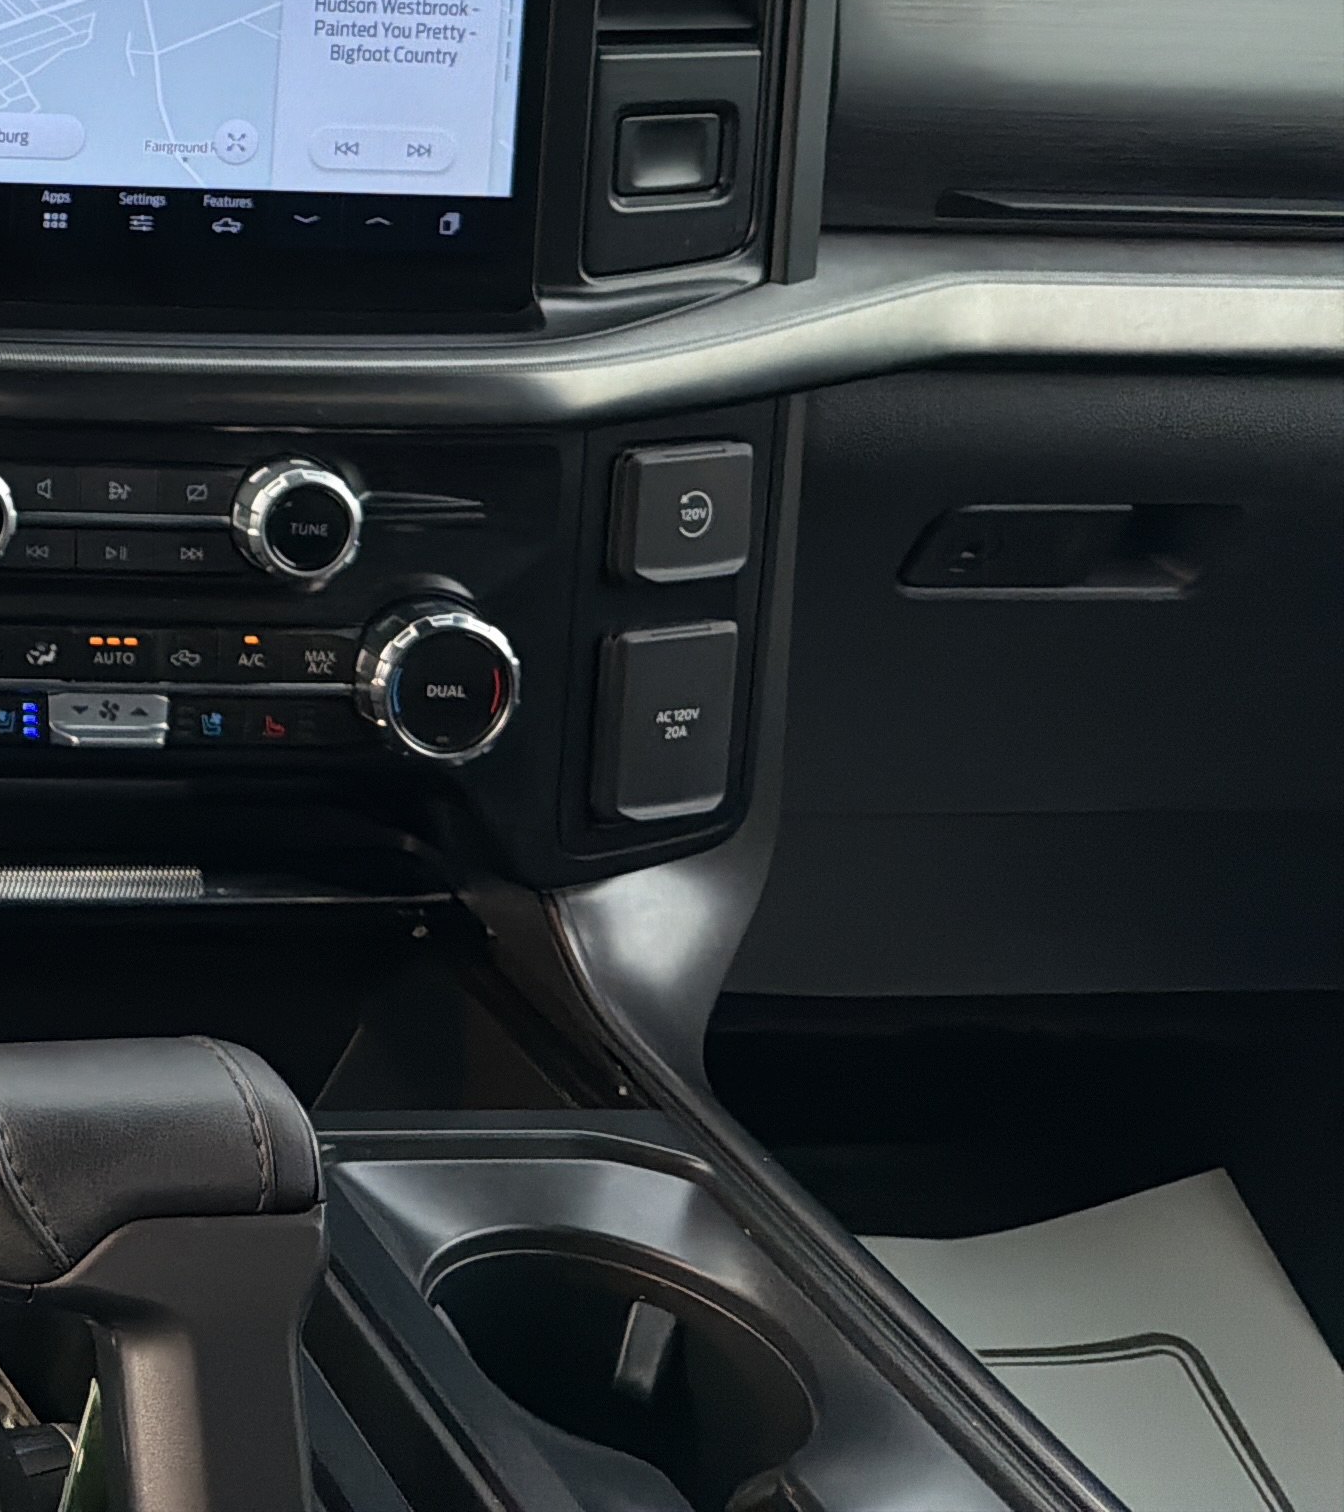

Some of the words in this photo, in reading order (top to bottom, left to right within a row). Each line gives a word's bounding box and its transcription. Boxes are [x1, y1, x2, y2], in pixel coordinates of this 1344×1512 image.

[314, 19, 378, 38] Painted
[382, 21, 412, 39] You
[415, 22, 466, 44] Pretty
[329, 43, 391, 65] Bigfoot
[393, 45, 459, 67] Country
[143, 139, 209, 156] Fairground
[41, 189, 72, 205] Apps
[118, 191, 167, 208] Settings
[203, 194, 254, 209] Features
[680, 507, 708, 522] 120V
[289, 522, 330, 538] TUNE
[93, 650, 135, 665] AUTO
[237, 652, 266, 668] A/C
[304, 649, 337, 663] MAX
[307, 661, 333, 675] A/C
[426, 684, 467, 699] DUAL
[655, 710, 673, 724] AC
[673, 707, 701, 722] 120V
[663, 725, 688, 740] 20A
